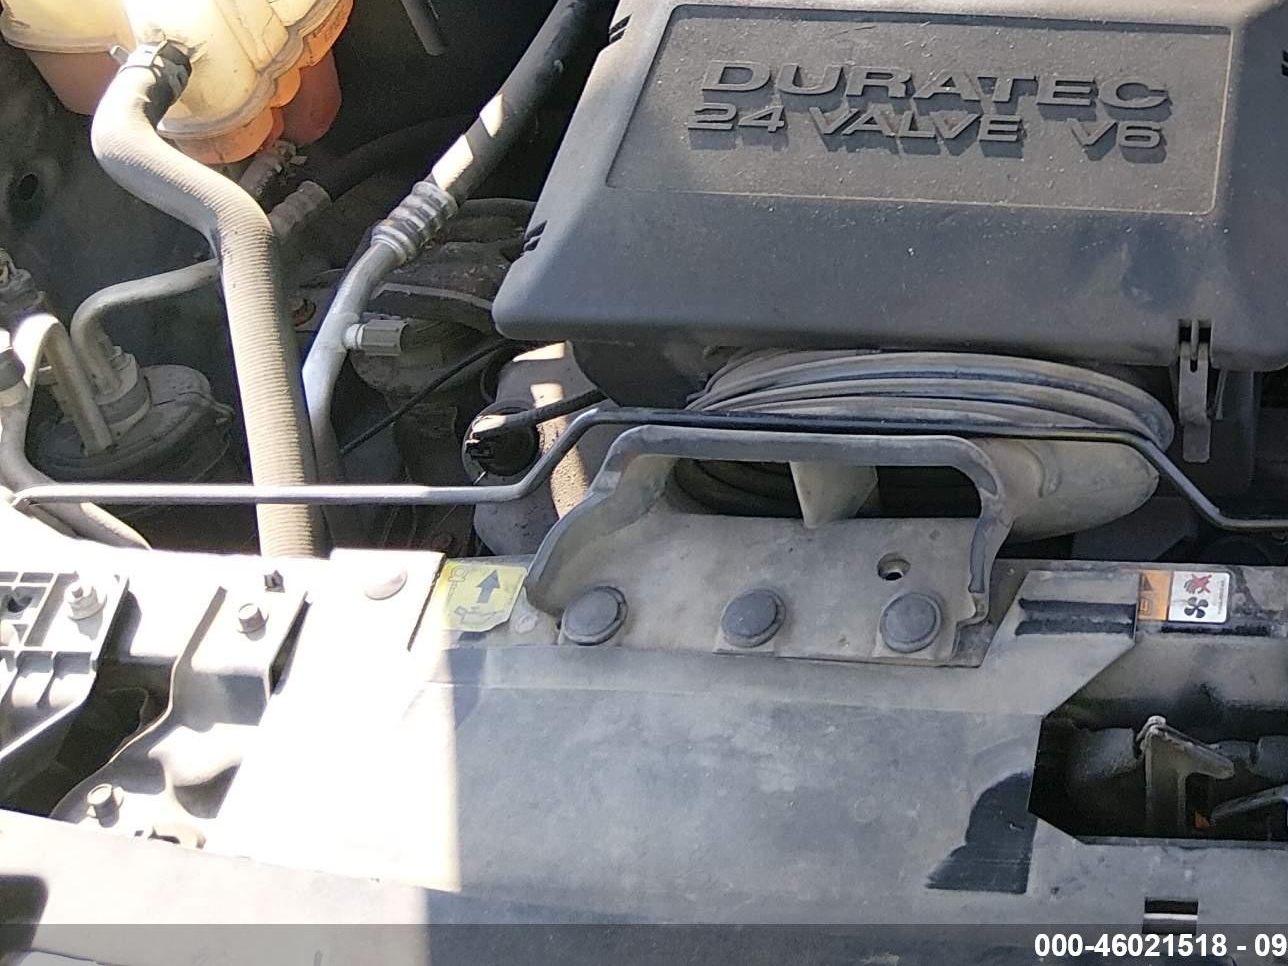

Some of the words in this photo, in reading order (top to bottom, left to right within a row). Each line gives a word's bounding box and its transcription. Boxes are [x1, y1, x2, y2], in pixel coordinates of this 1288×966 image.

[700, 59, 1171, 110] DURATEC
[687, 101, 786, 133] 24
[808, 104, 1023, 143] VALVE
[1065, 115, 1163, 149] V6
